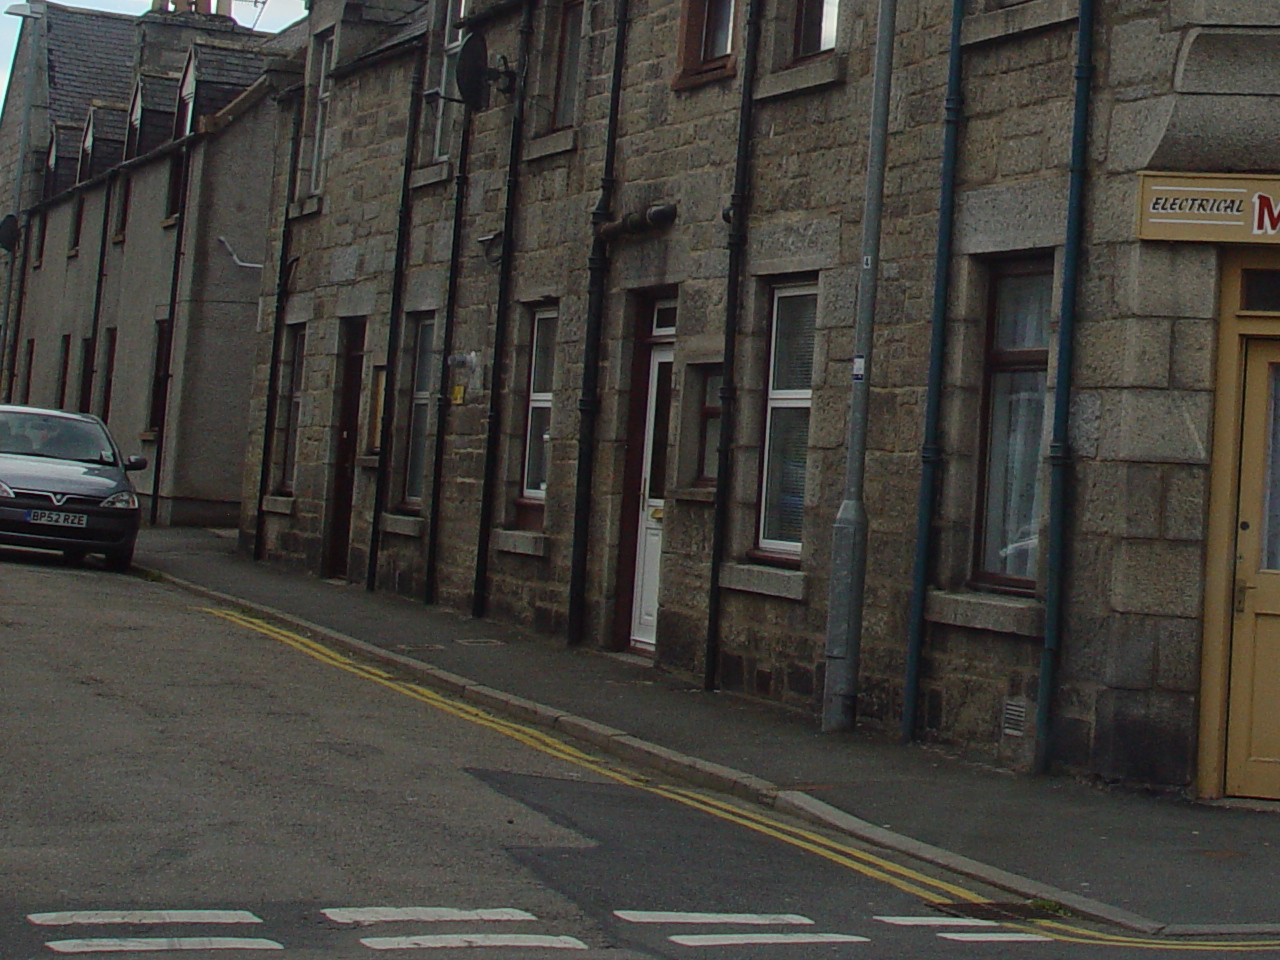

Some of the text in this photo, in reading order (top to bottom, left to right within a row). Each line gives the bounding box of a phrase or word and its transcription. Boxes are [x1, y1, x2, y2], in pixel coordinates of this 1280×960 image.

[1150, 197, 1245, 214] ELECTRICAL
[32, 511, 85, 526] BP52 RZE
